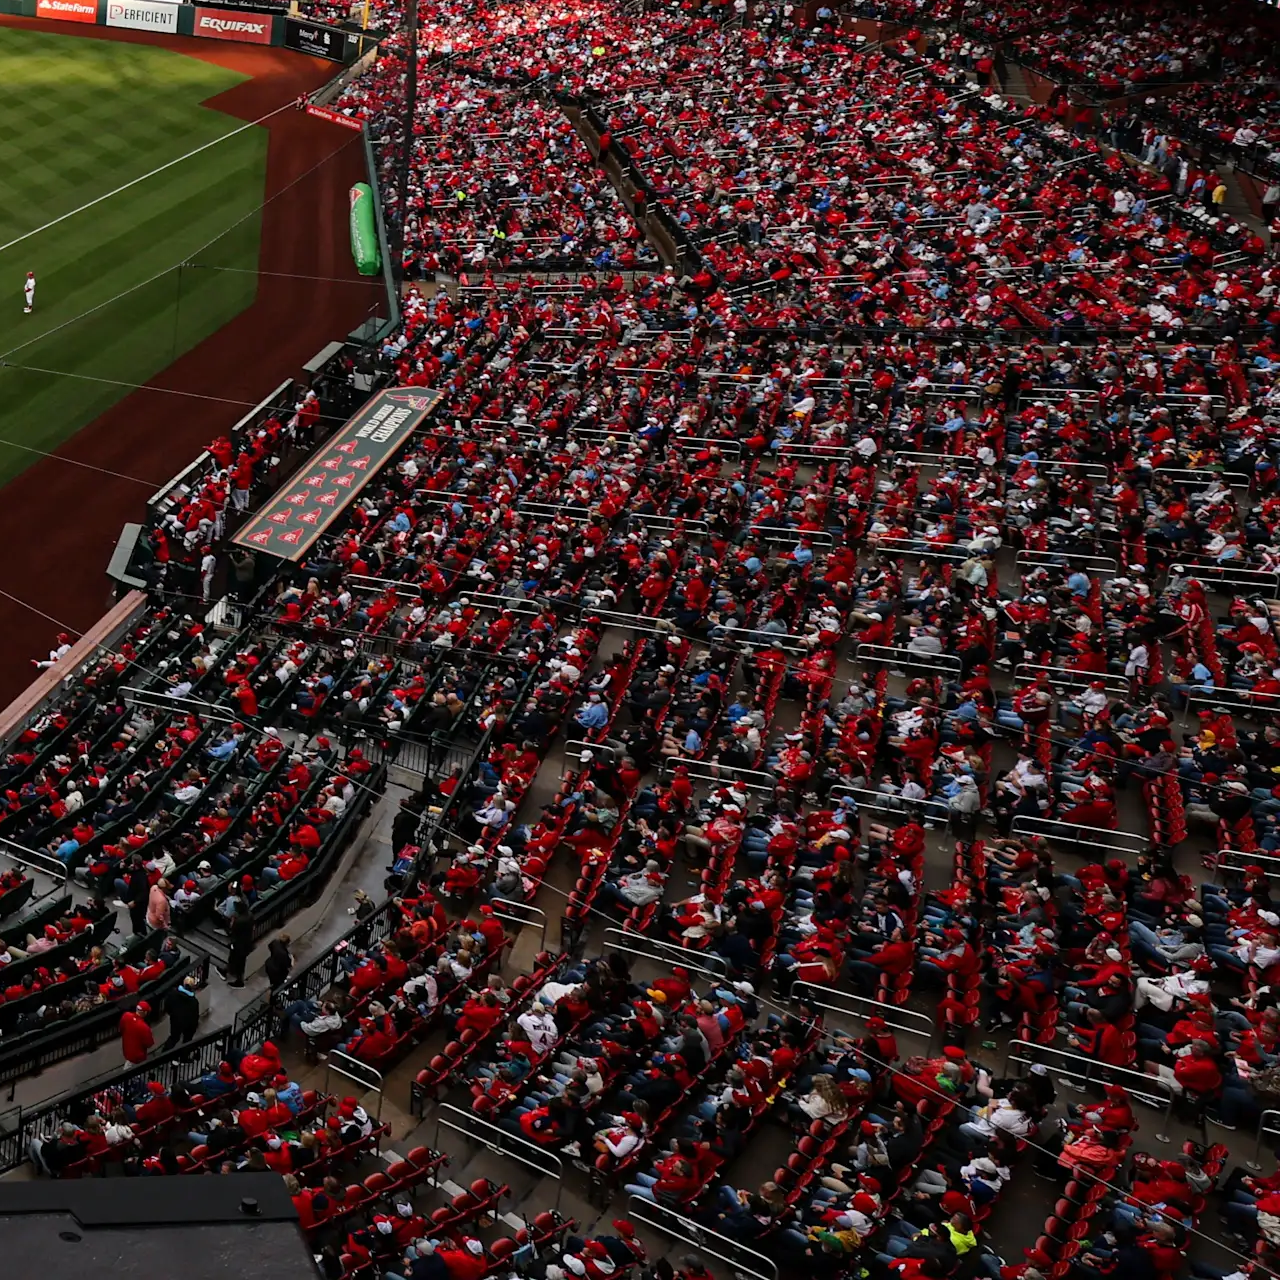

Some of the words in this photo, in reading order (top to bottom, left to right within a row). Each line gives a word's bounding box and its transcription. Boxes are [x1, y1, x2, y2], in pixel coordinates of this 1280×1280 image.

[110, 4, 173, 25] PERFICIENT
[200, 16, 264, 34] EQUIFAX
[370, 407, 412, 442] CHAMPIONS
